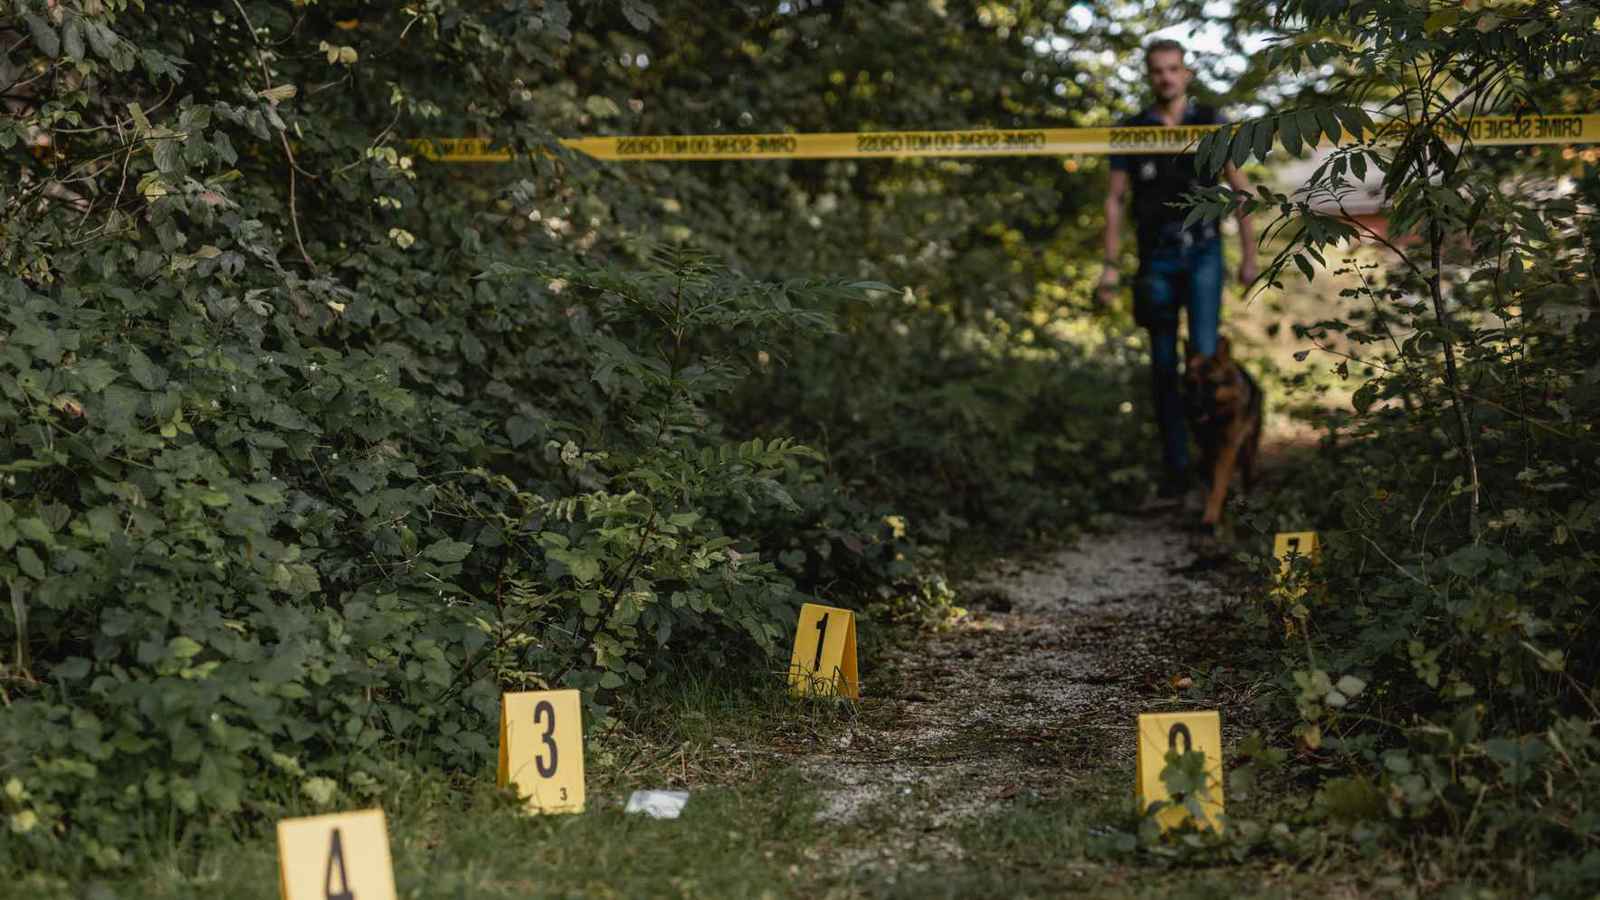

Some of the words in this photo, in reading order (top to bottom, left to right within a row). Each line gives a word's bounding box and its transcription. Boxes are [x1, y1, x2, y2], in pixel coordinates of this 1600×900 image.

[812, 611, 828, 673] 1
[534, 700, 558, 779] 3
[559, 787, 568, 801] 3
